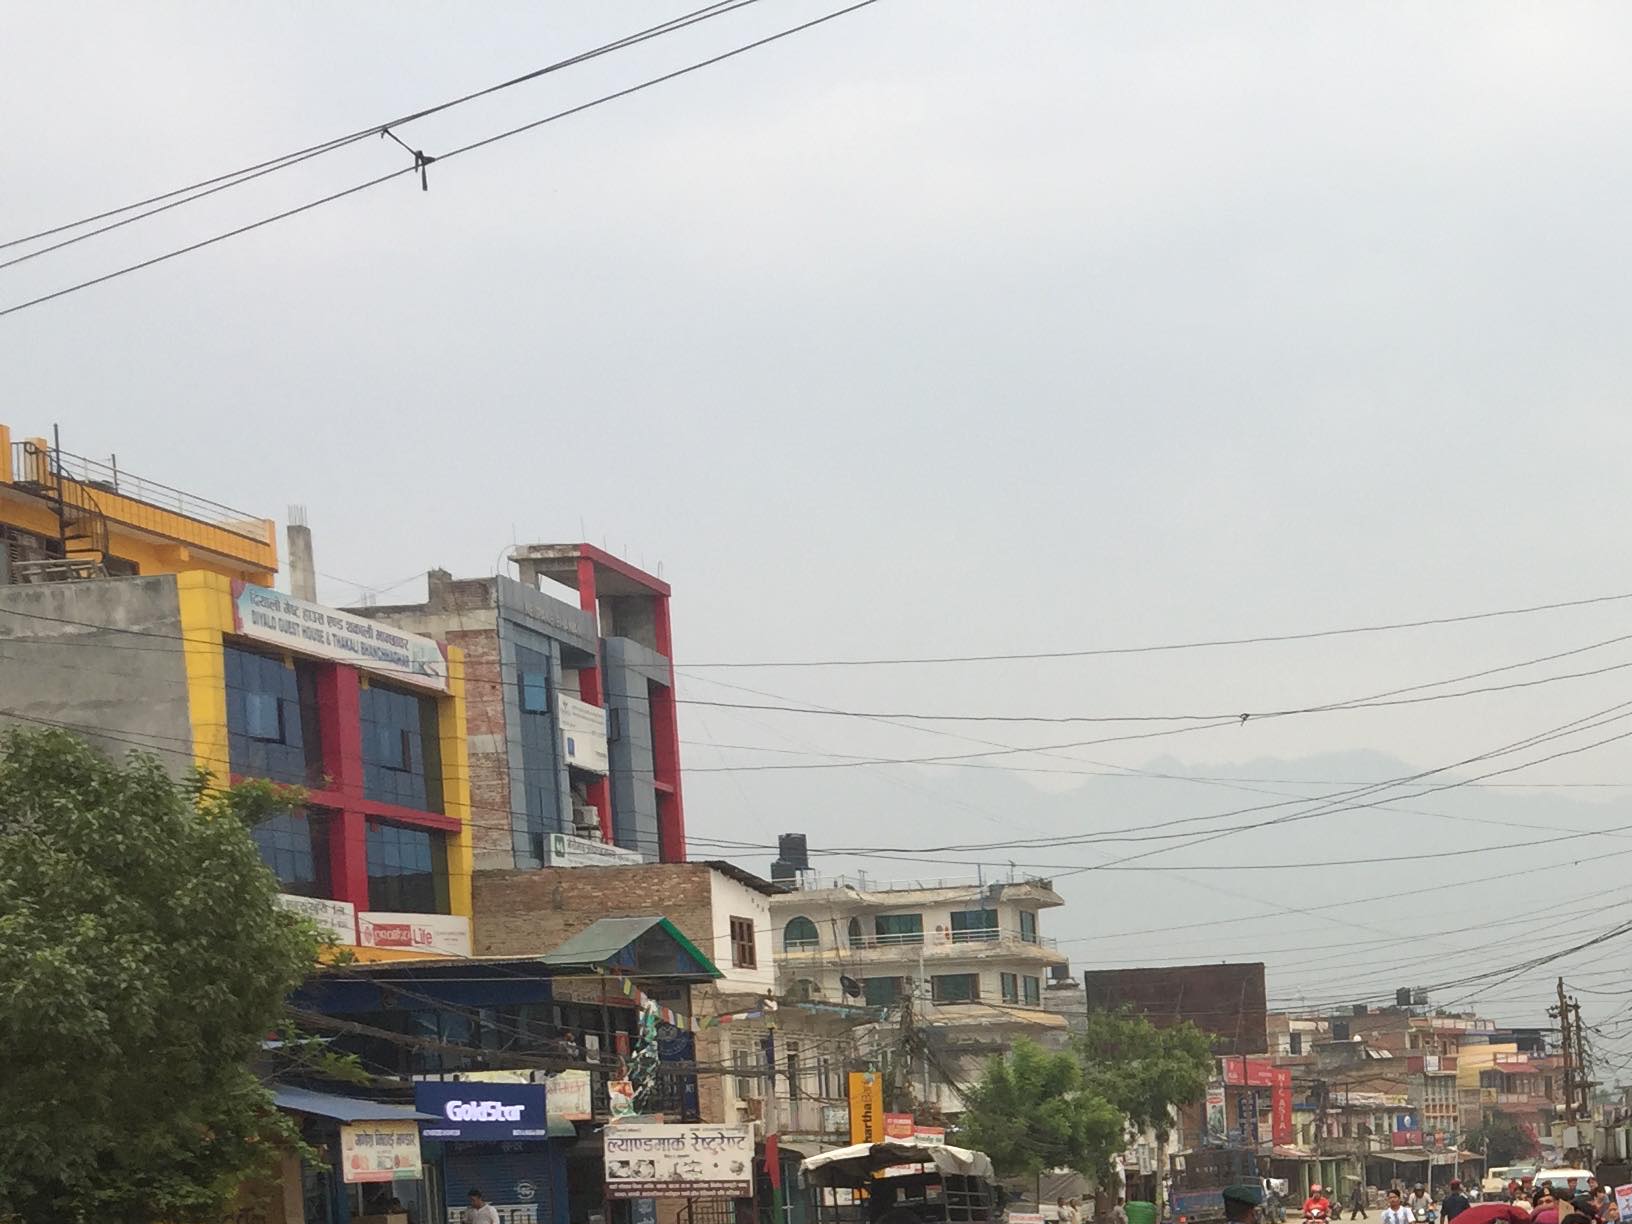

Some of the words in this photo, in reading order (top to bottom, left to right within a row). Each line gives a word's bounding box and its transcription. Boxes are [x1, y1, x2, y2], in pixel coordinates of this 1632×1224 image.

[279, 617, 300, 638] GUEST
[302, 624, 324, 644] HOUSE
[326, 633, 331, 645] &
[332, 634, 360, 654] THAKALI
[445, 1100, 525, 1122] GoldStar
[608, 1134, 685, 1152] ल्याण्डमार्क
